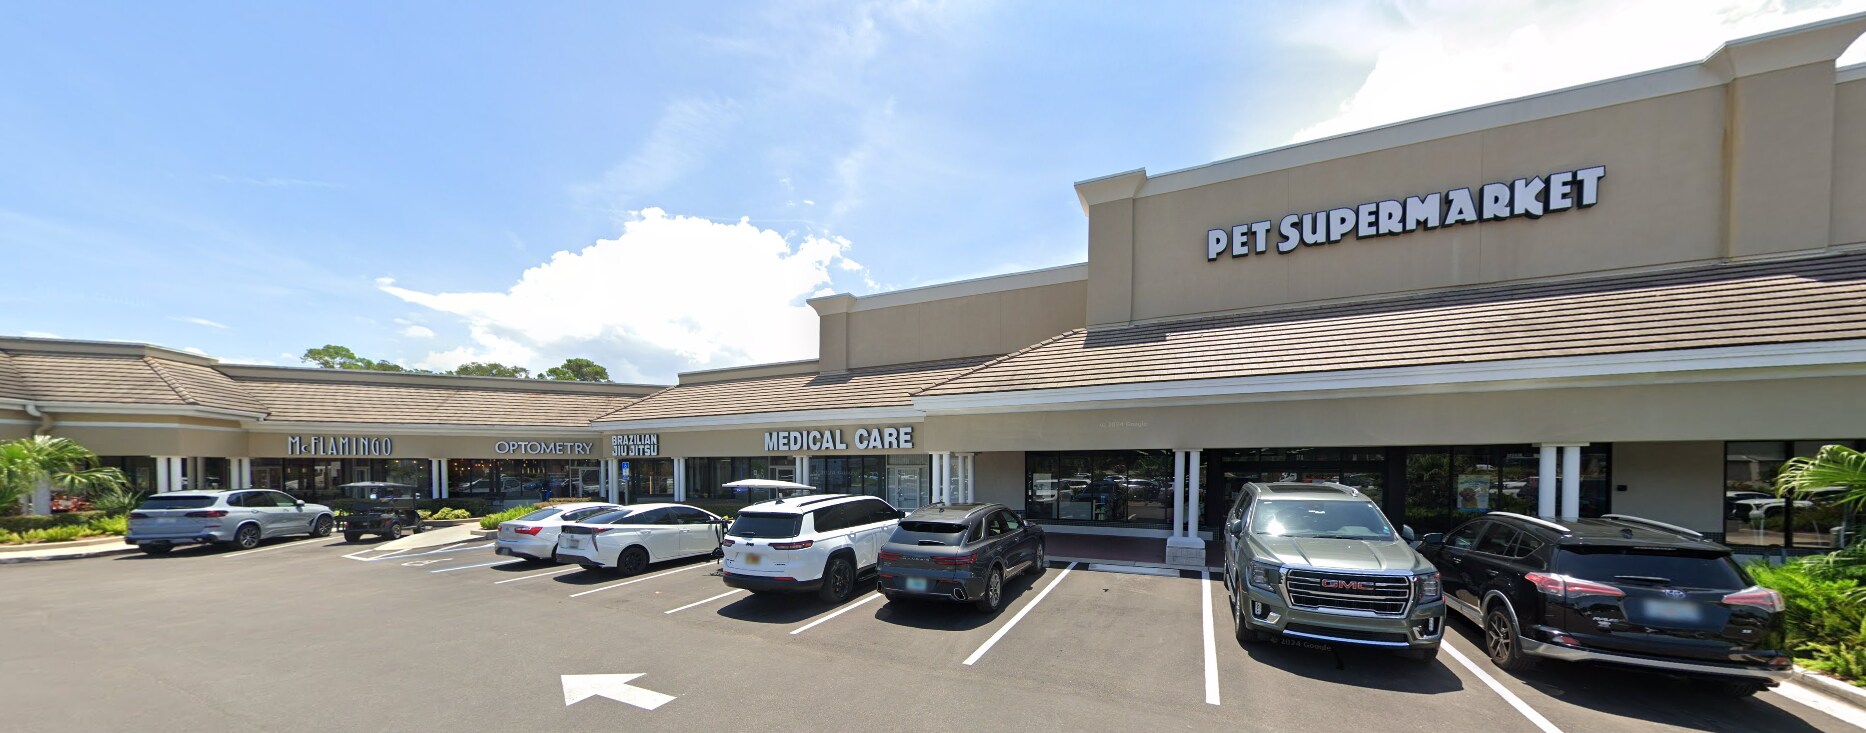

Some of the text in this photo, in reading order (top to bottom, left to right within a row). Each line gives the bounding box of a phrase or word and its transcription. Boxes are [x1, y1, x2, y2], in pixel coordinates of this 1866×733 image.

[1207, 165, 1606, 262] PET SUPERMARKET
[611, 434, 659, 446] BRAZILIAN
[764, 426, 914, 451] MEDICAL CARE
[495, 441, 593, 455] OPTOMETRY
[612, 445, 659, 456] JIU JITSU
[1321, 579, 1375, 591] GMC
